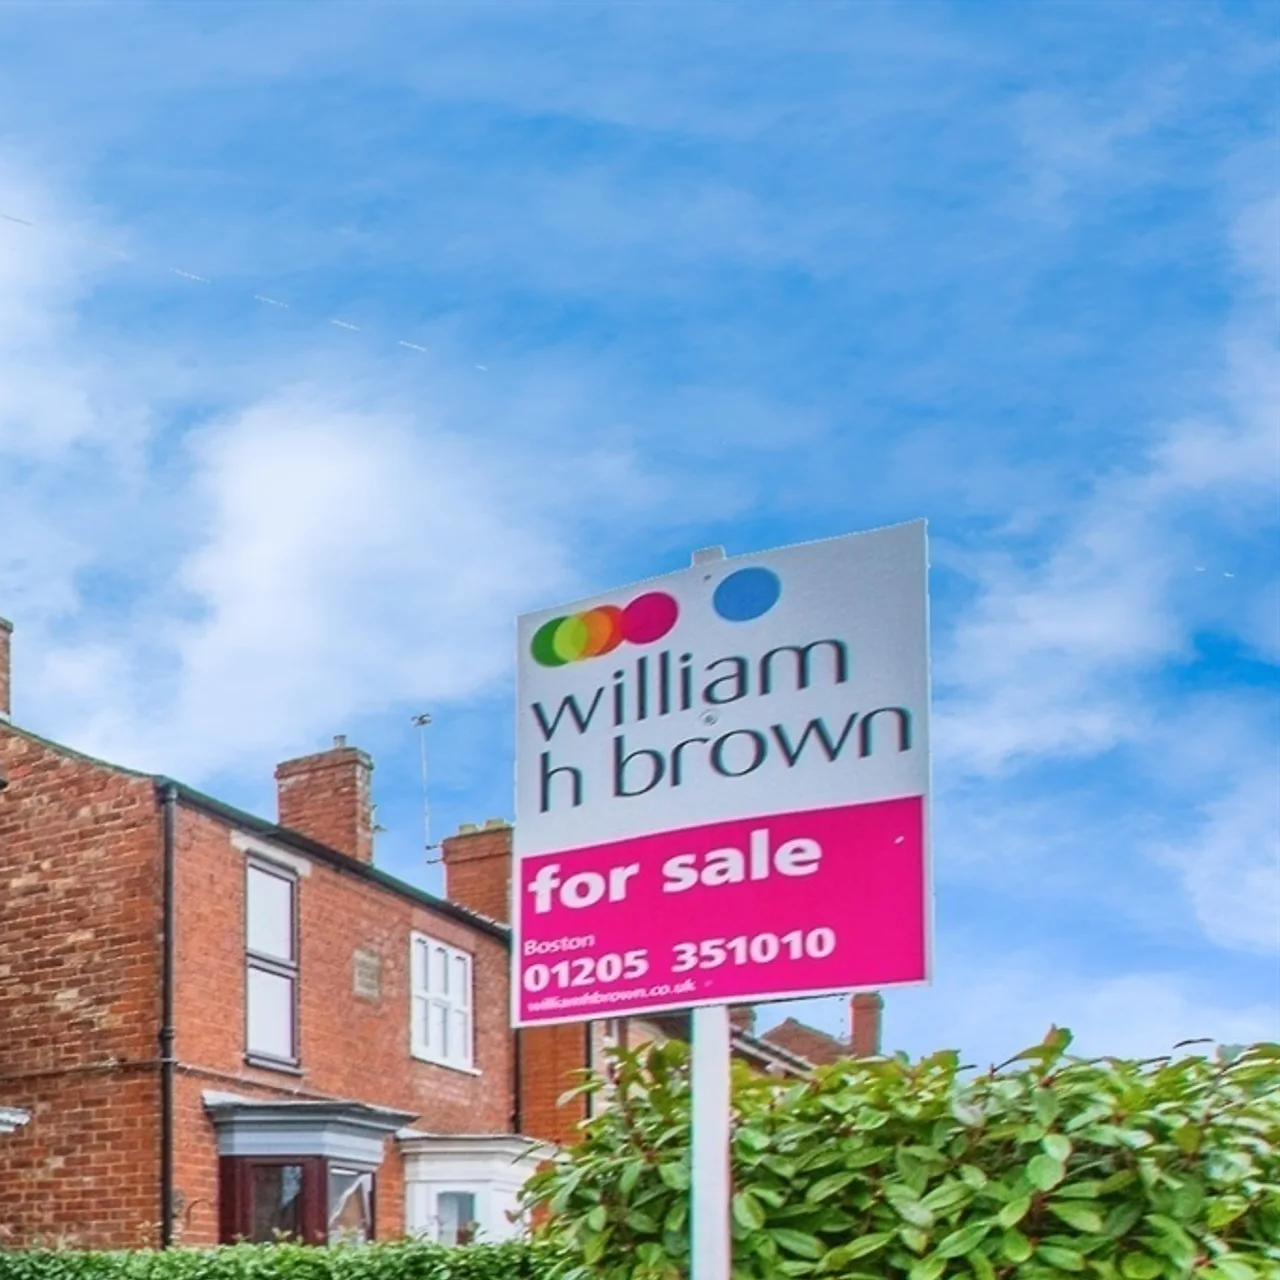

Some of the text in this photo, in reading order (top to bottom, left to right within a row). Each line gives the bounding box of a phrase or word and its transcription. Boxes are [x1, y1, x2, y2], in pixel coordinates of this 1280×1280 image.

[531, 638, 848, 742] william
[540, 705, 912, 813] h brown
[528, 829, 822, 914] for sale
[523, 926, 836, 992] 01205 351010
[524, 934, 595, 956] Boston
